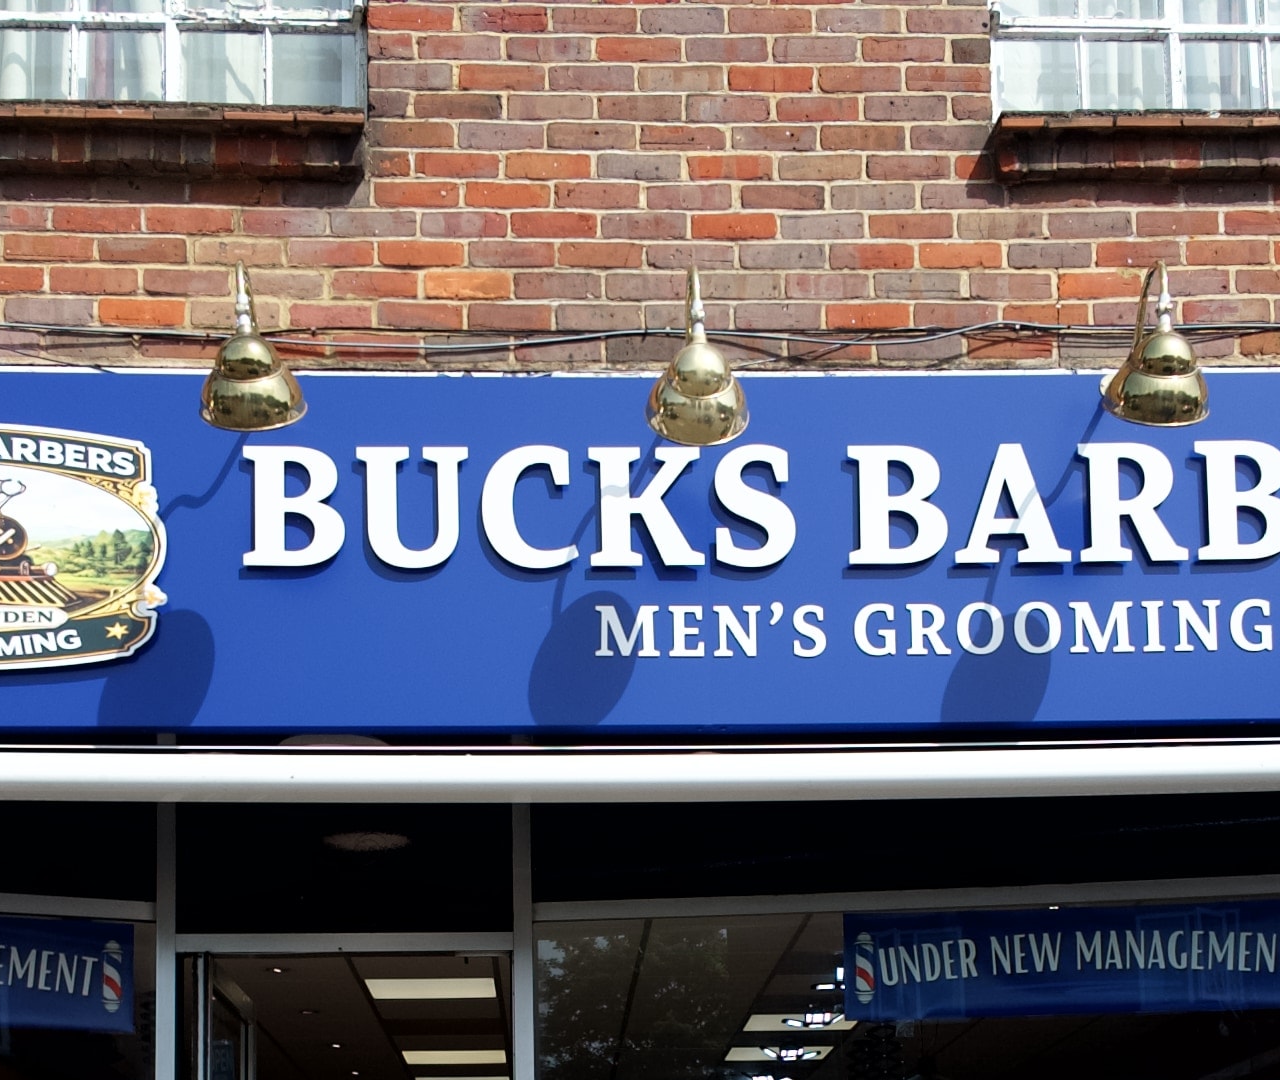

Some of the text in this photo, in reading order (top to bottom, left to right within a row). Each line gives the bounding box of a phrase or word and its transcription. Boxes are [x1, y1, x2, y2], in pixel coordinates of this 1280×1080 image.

[242, 442, 798, 570] BUCKS
[854, 597, 1275, 658] GROOMING
[879, 938, 979, 987] UNDER
[989, 931, 1062, 975] NEW
